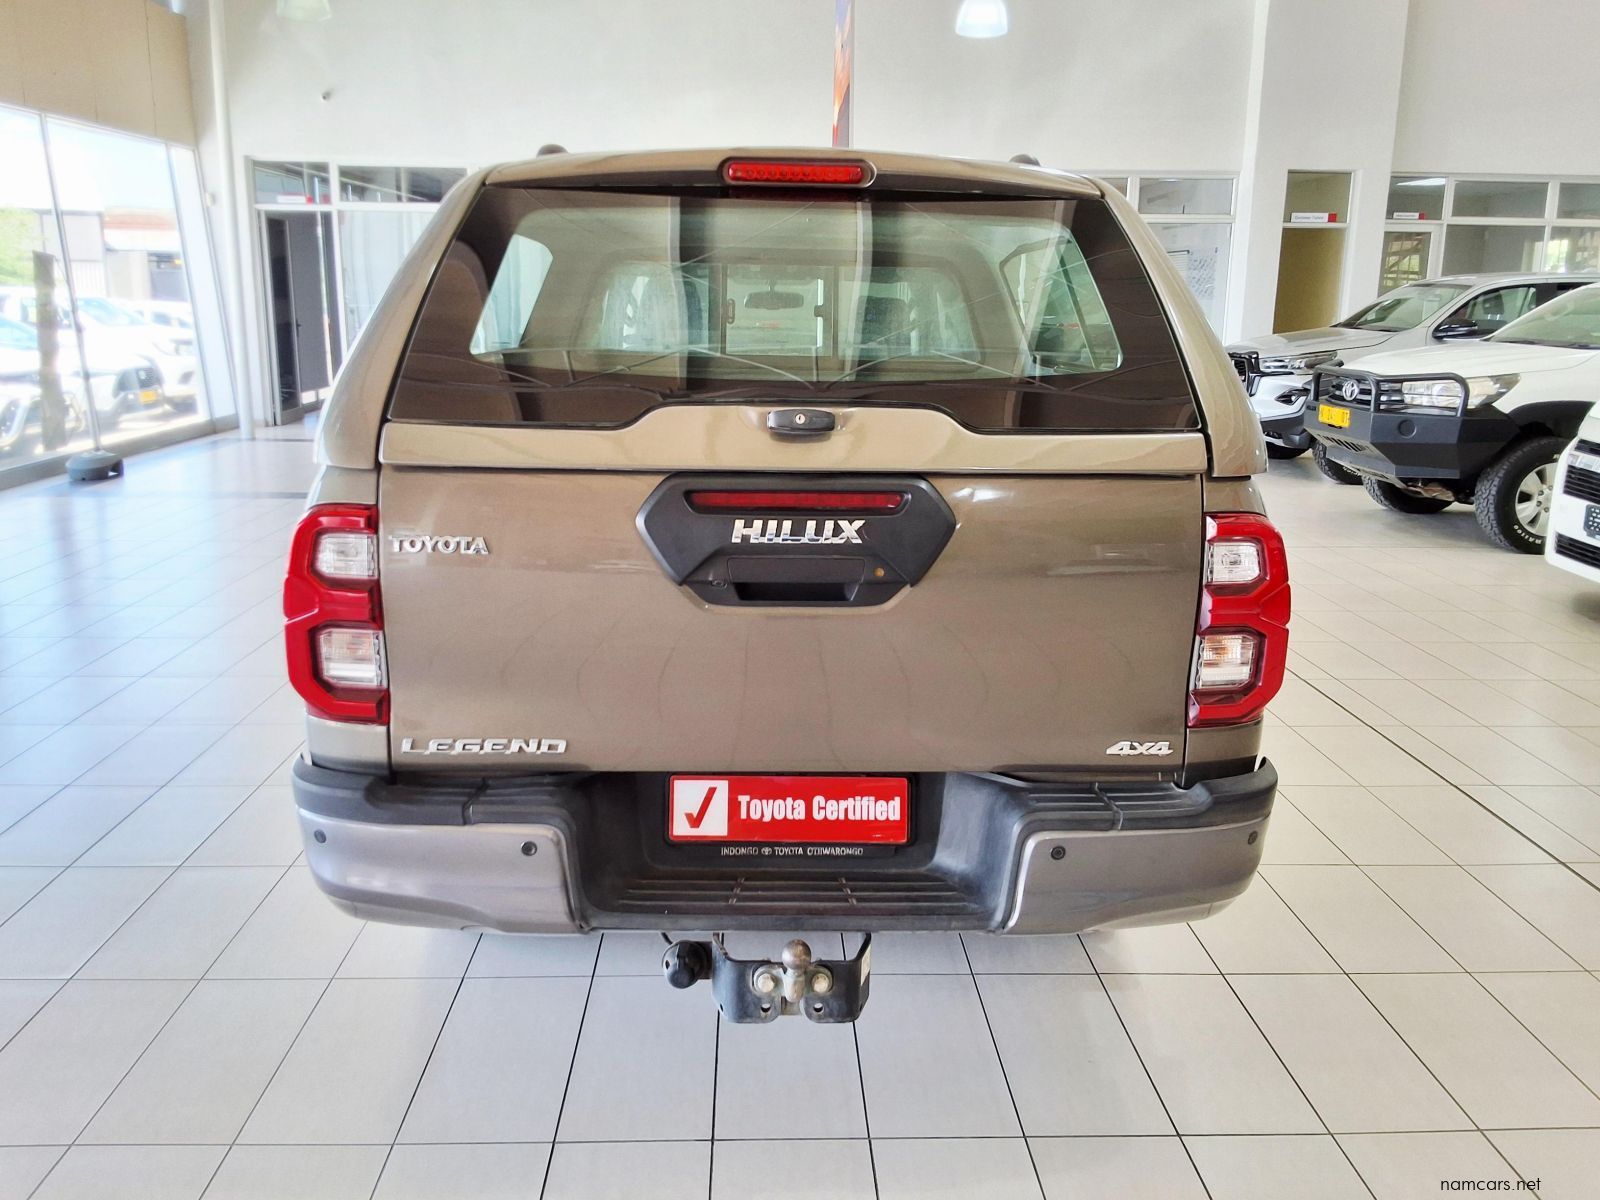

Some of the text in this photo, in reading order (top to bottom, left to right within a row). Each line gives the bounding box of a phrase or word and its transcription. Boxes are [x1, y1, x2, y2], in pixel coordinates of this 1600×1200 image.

[731, 519, 865, 544] HILUX
[388, 535, 488, 554] TOYOTA
[401, 737, 567, 755] LEGEND
[737, 794, 901, 823] Toyota Certified
[720, 846, 759, 856] INDONGO
[774, 846, 804, 856] TOYOTA
